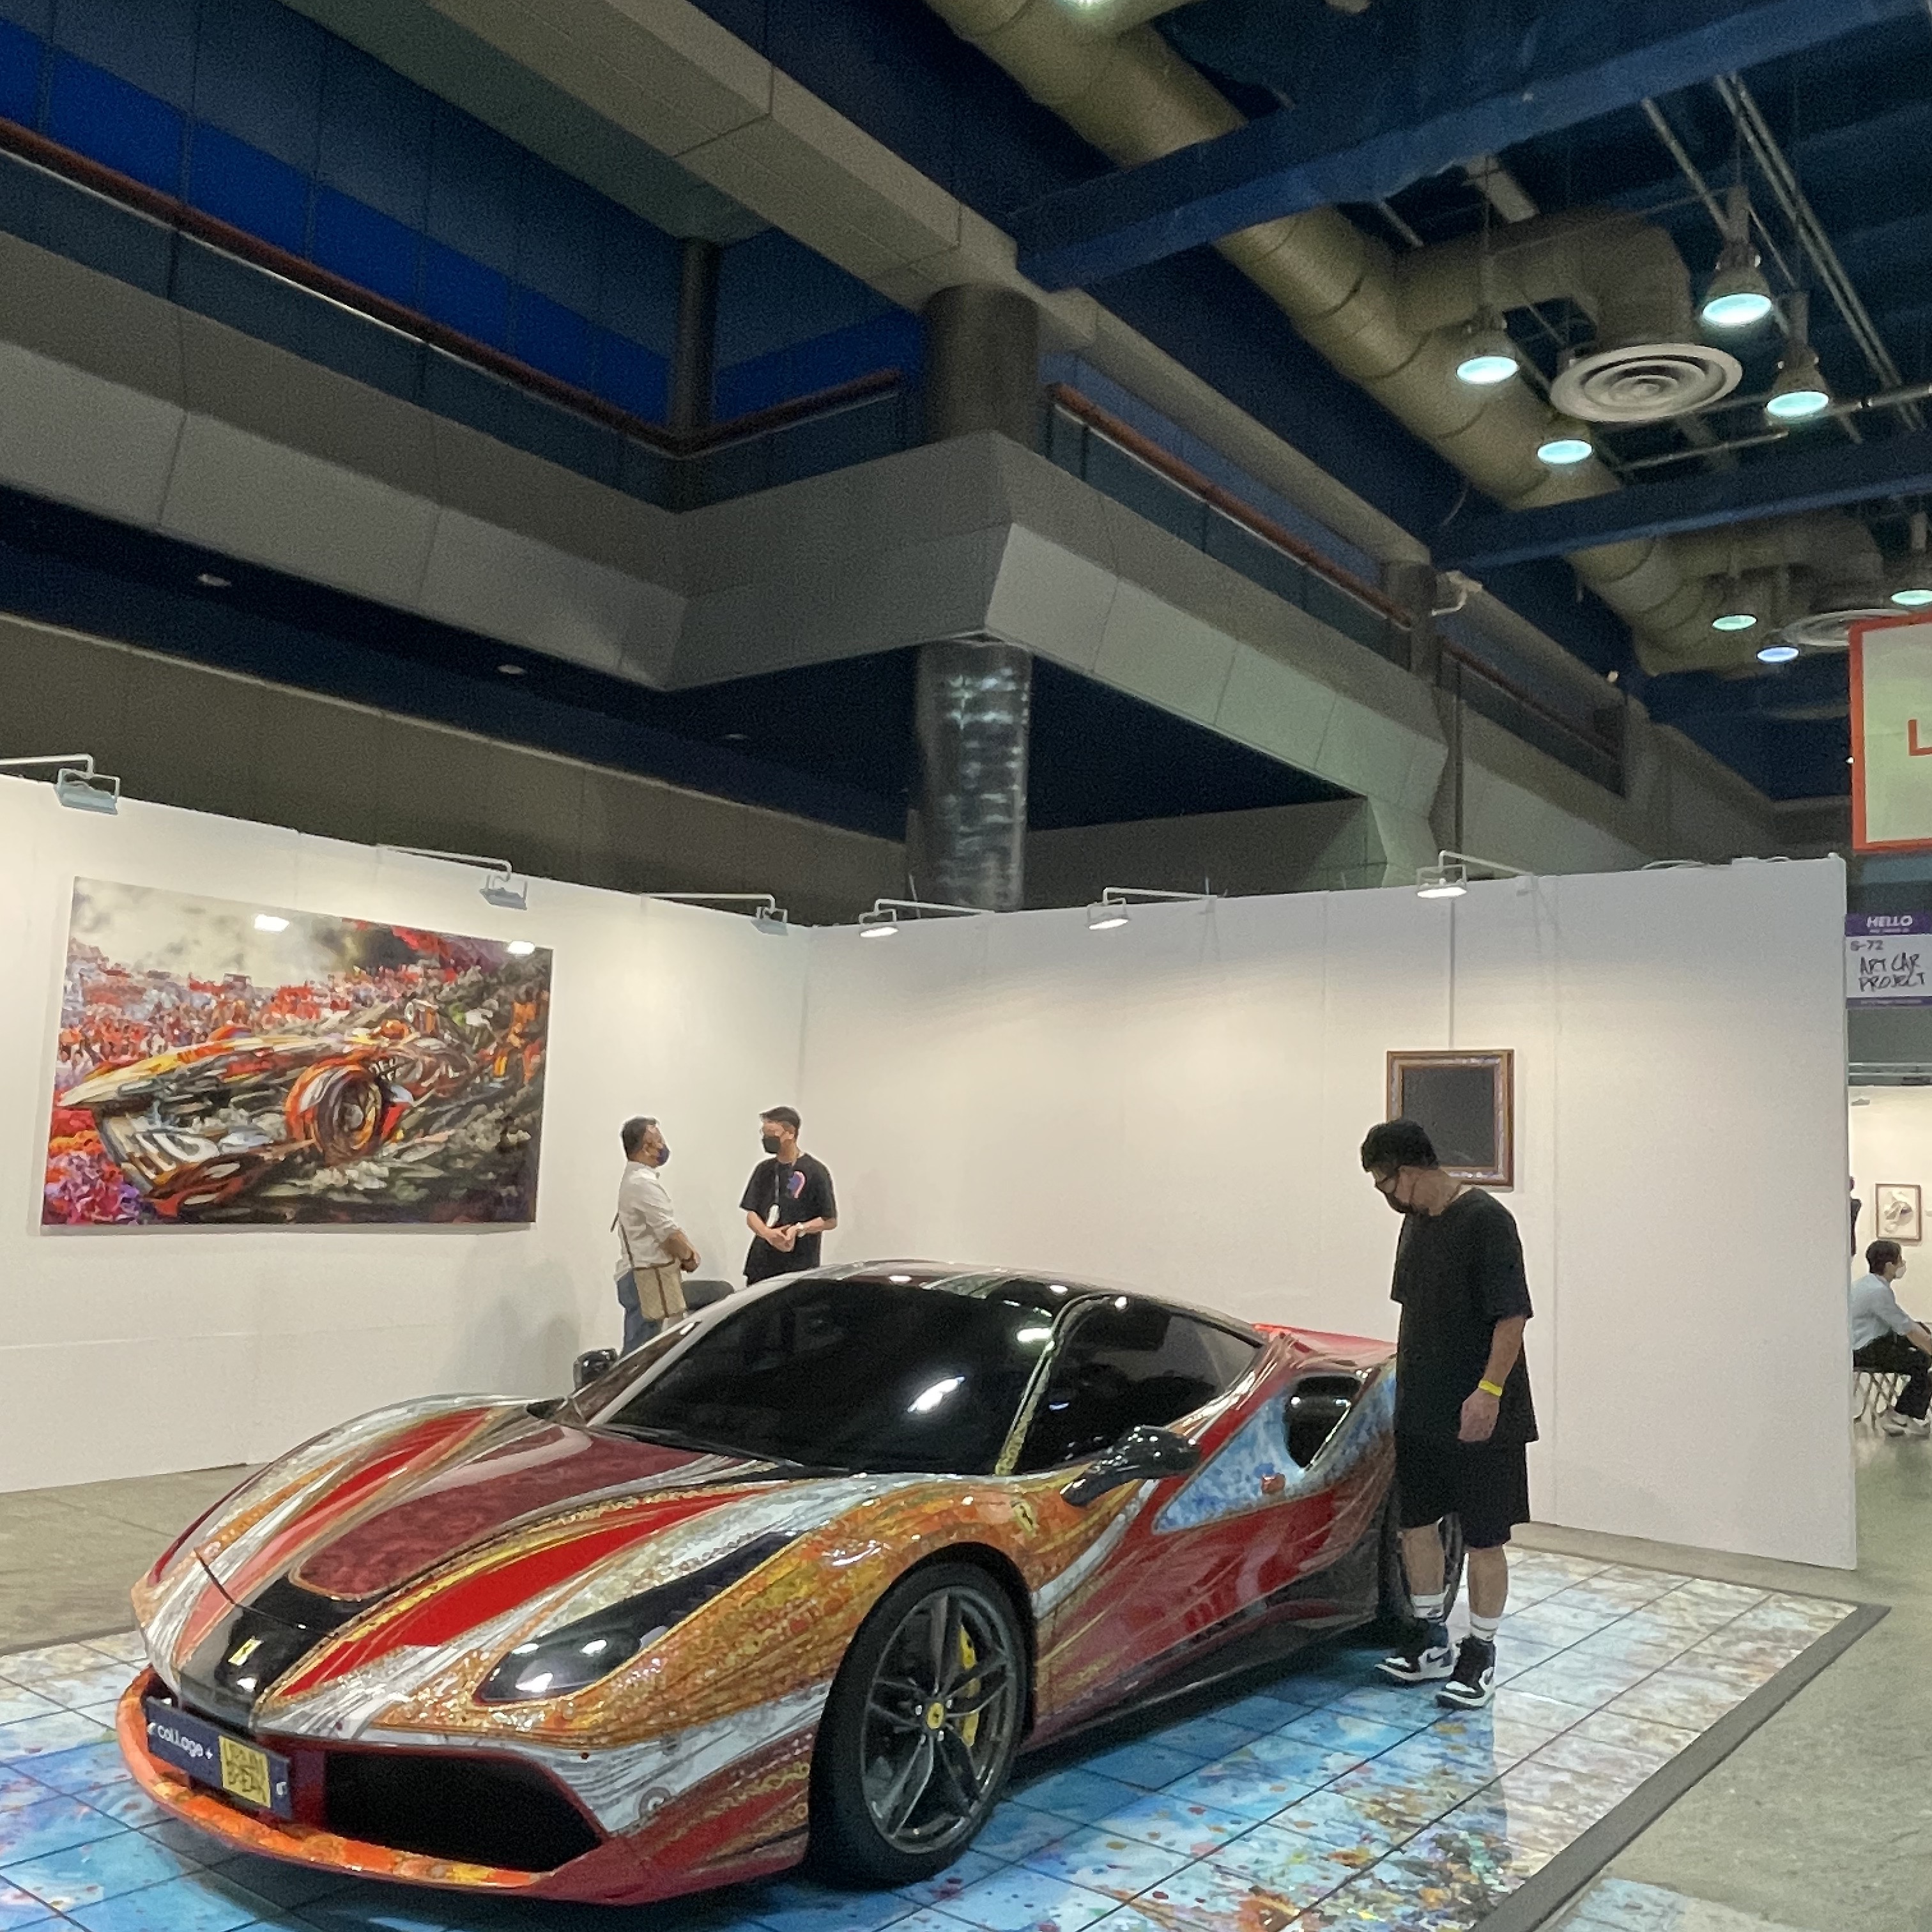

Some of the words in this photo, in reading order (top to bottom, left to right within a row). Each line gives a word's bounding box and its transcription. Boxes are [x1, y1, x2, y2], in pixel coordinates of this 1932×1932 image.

[1866, 915, 1913, 928] HELLO
[1891, 952, 1921, 972] CAR
[1858, 972, 1925, 992] PROJECT
